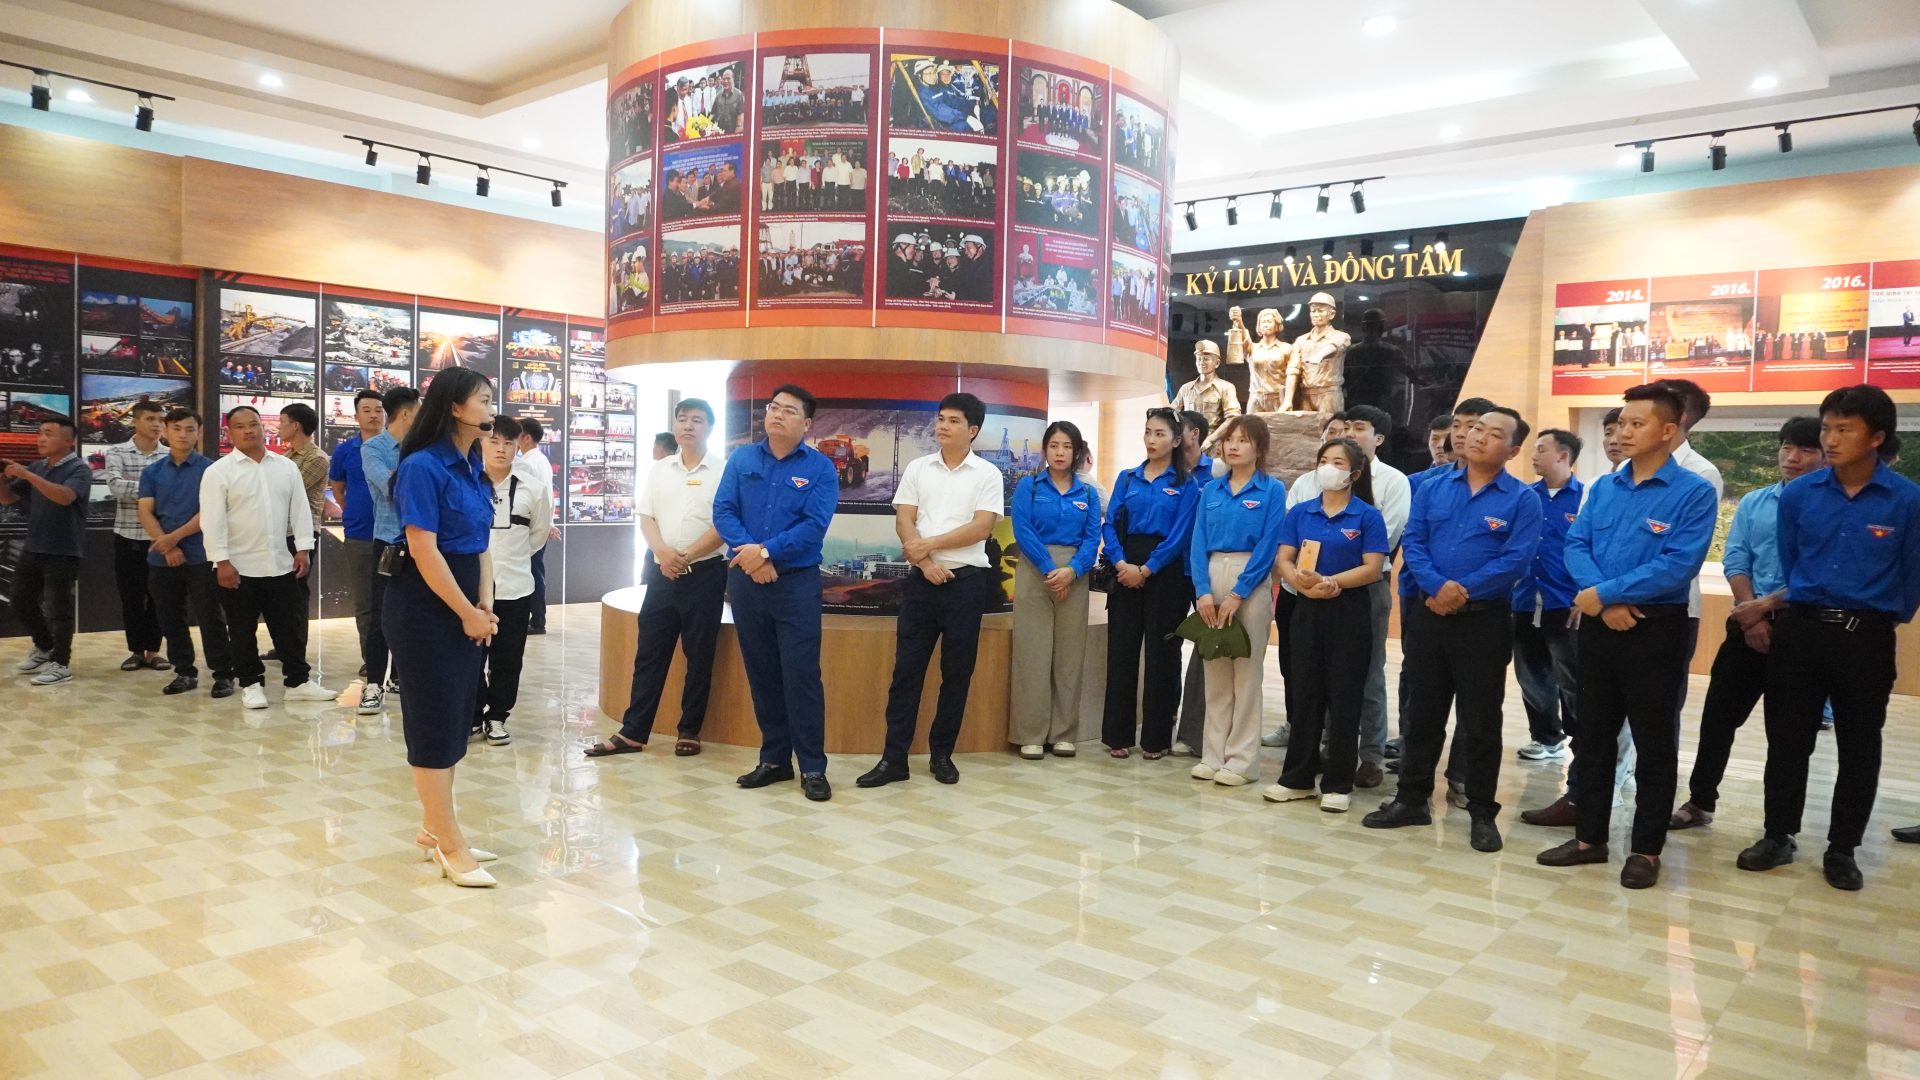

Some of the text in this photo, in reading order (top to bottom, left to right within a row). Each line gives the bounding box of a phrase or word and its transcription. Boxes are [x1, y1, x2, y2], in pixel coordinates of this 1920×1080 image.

[1185, 244, 1464, 296] KỶ LUẬT VÀ ĐỒNG TÂM
[1820, 275, 1866, 289] 2016.
[1605, 289, 1644, 302] 2014.
[1710, 282, 1751, 297] 2016.
